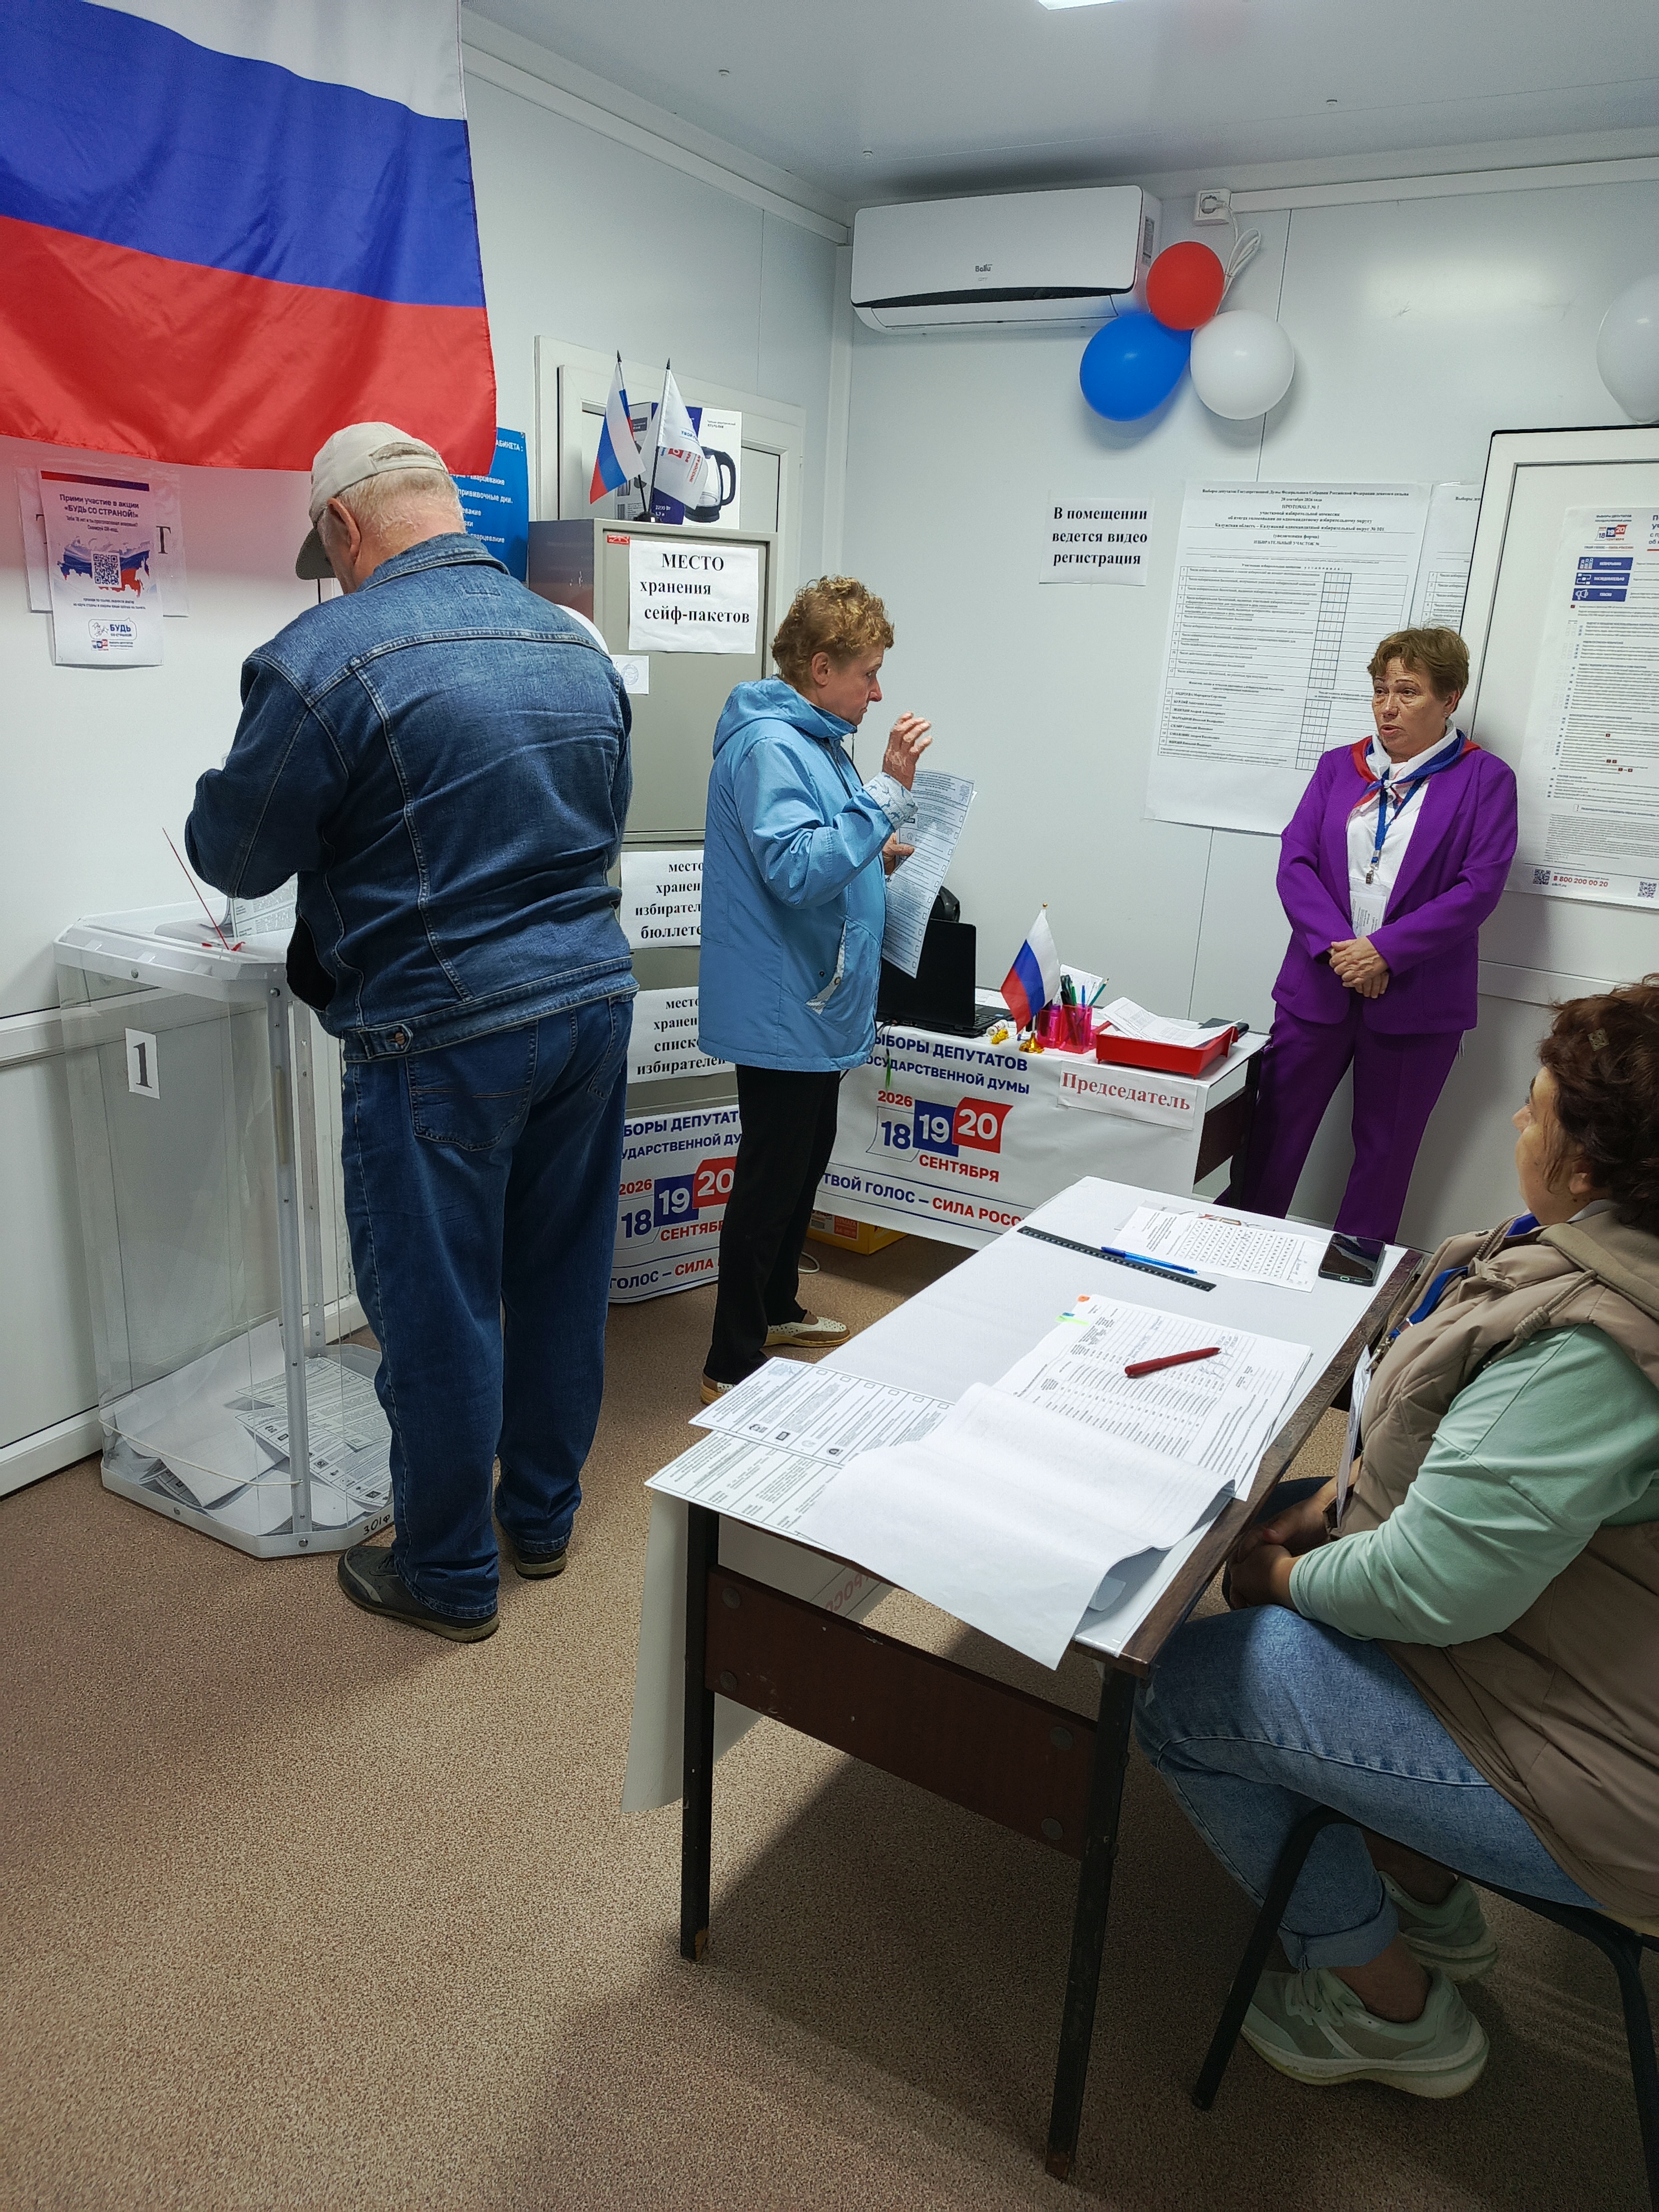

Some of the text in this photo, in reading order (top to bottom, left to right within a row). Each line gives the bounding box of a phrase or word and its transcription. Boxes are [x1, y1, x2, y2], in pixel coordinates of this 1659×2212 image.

[496, 439, 523, 452] АБИНЕТА:
[60, 494, 84, 503] Прими
[84, 497, 111, 506] участие
[65, 505, 86, 513] «БУДЬ
[462, 508, 481, 516] евание
[1054, 507, 1147, 521] В помещении
[1052, 533, 1148, 544] ведется видео
[662, 553, 724, 571] МЕСТО
[1053, 553, 1141, 567] регистрация
[639, 581, 711, 596] хранения
[644, 605, 749, 624] сейф-пакетов
[110, 624, 131, 633] БУДЬ
[668, 862, 704, 872] место
[656, 883, 701, 896] хранен
[636, 904, 701, 917] избирател
[641, 925, 701, 939] бюллете
[653, 1017, 697, 1032] хранен
[654, 1039, 699, 1052] списк
[875, 1034, 1028, 1071] ЫБОРЫ ДЕПУТАТОВ
[133, 1042, 153, 1089] 1
[866, 1055, 1030, 1094] ОСУДАРСТВЕННОЙ ДУМЫ
[877, 1090, 913, 1107] 2026
[1061, 1072, 1190, 1110] Председатель
[624, 1110, 739, 1137] БОРЫ ДЕПУТАТ
[919, 1114, 949, 1143] 19
[958, 1108, 998, 1140] 20
[881, 1121, 911, 1149] 18
[622, 1133, 742, 1160] УДАРСТВЕННОЙ ДУ
[919, 1154, 1000, 1182] СЕНТЯБРЯ
[619, 1179, 652, 1195] 2026
[697, 1168, 735, 1196] 20
[659, 1187, 690, 1215] 19
[824, 1172, 861, 1191] ТВОЙ
[865, 1182, 915, 1203] ГОЛОС
[933, 1197, 974, 1217] СИЛА
[979, 1208, 1021, 1226] РОСС
[622, 1209, 652, 1238] 18
[661, 1220, 724, 1241] СЕНТЯБР
[609, 1270, 658, 1289] ГОЛОС
[675, 1258, 714, 1275] СИЛА
